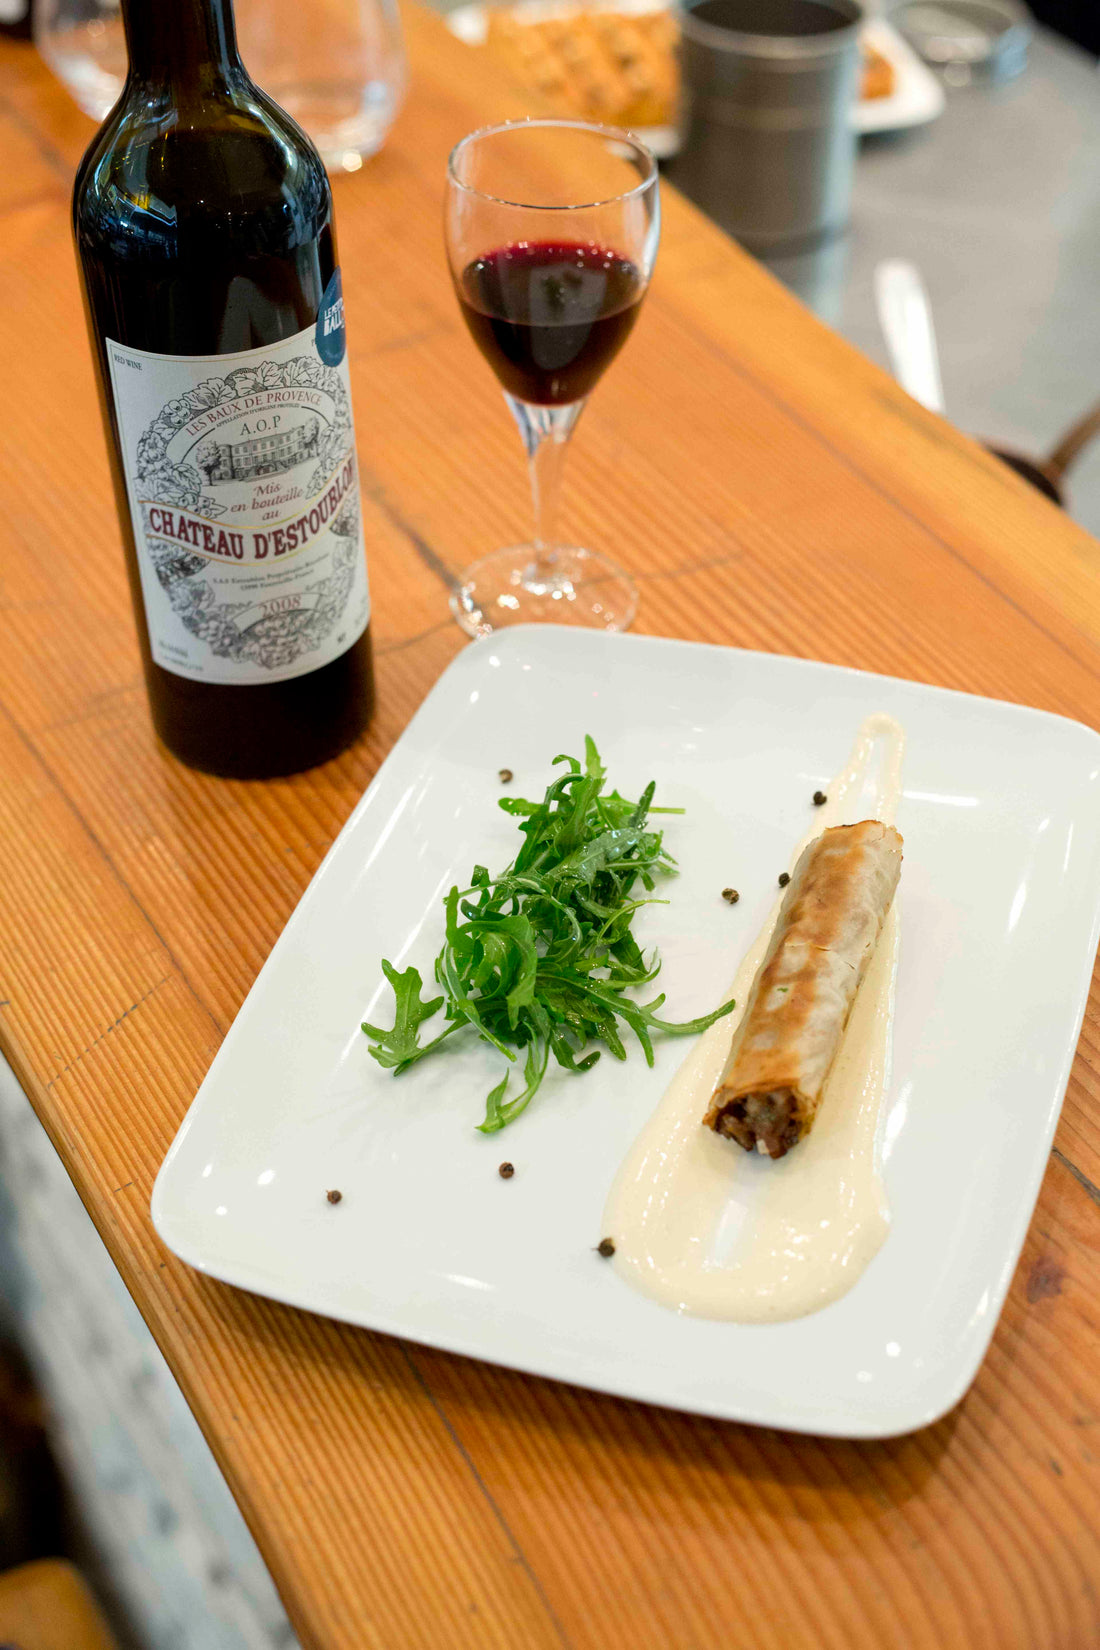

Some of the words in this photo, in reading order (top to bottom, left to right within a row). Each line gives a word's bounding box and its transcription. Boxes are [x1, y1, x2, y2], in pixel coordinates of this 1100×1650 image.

[185, 420, 208, 437] LES
[207, 402, 242, 423] BAUX
[244, 395, 265, 410] DE
[266, 390, 322, 405] PROVENCE
[230, 503, 247, 513] en
[251, 486, 303, 510] bouteille
[253, 481, 281, 497] Mis
[262, 511, 280, 521] au
[149, 508, 245, 560] CHATEAU
